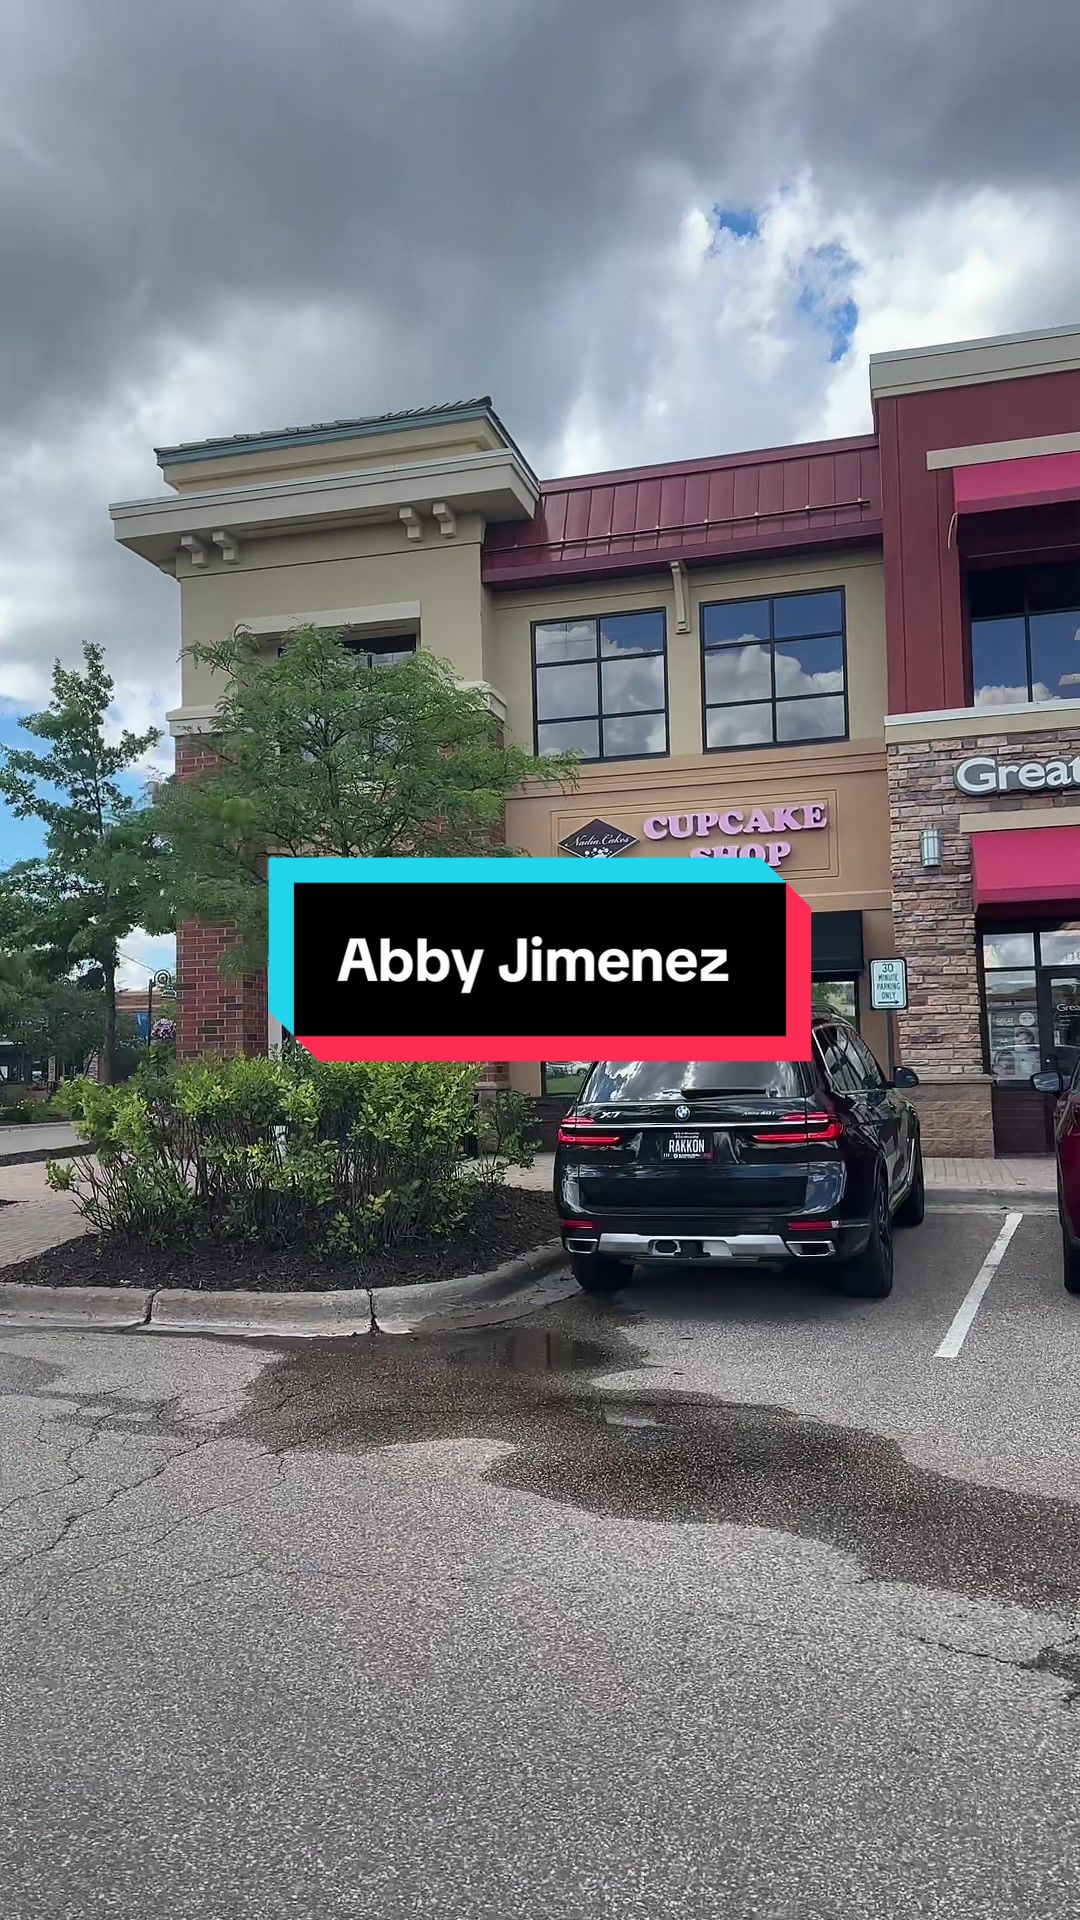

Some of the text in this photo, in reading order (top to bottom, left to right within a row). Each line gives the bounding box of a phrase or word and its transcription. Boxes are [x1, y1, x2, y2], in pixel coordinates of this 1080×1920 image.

[957, 756, 1080, 791] Great
[643, 803, 828, 841] CUPCAKE
[565, 833, 629, 847] Nadia Cakes
[881, 963, 894, 973] 30
[878, 973, 898, 981] MINUTE
[876, 982, 901, 991] PARKING
[881, 991, 896, 1000] ONLY
[600, 1111, 621, 1119] X7
[669, 1139, 705, 1153] RAKKON
